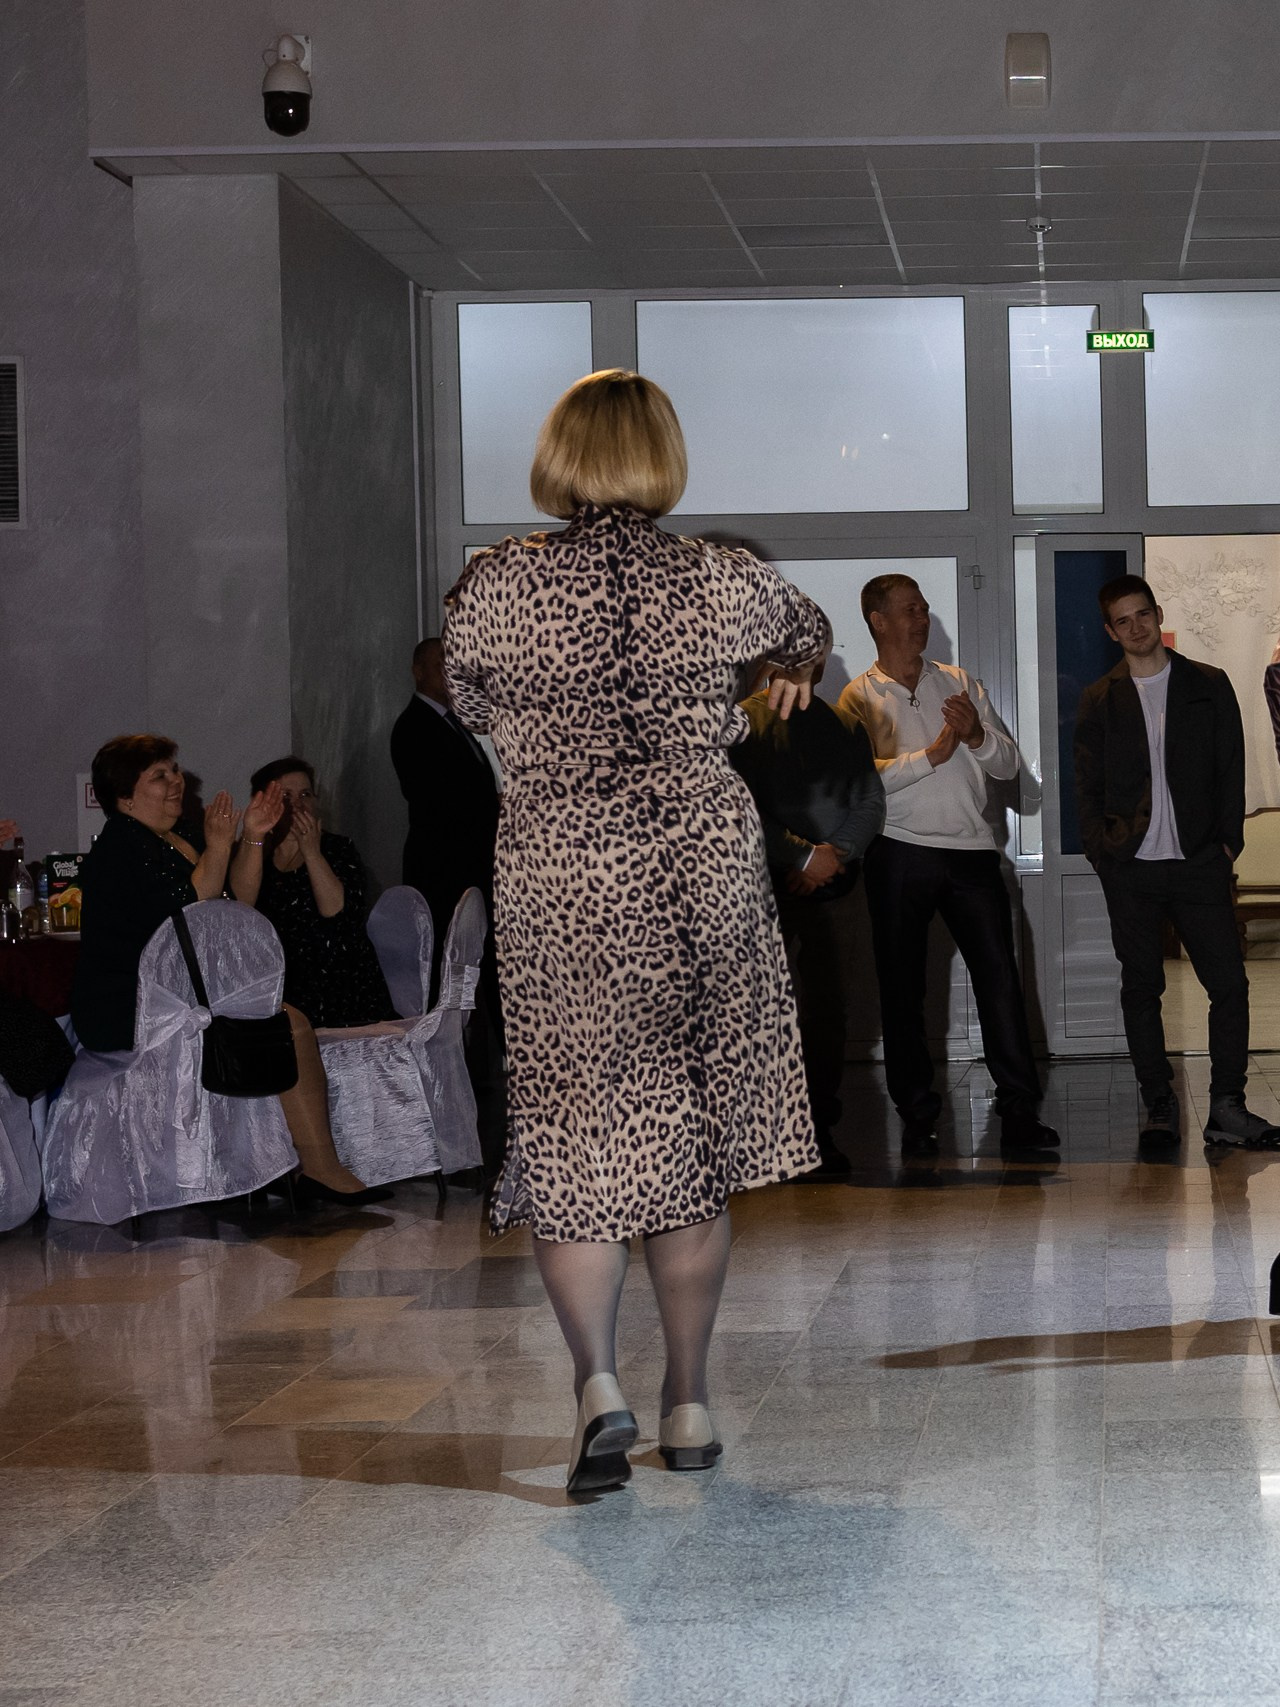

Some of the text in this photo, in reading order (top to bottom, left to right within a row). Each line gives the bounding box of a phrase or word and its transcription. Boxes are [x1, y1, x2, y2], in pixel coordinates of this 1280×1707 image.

[1093, 334, 1149, 348] ВЫХОД
[53, 860, 75, 870] Global
[55, 867, 79, 877] Village
